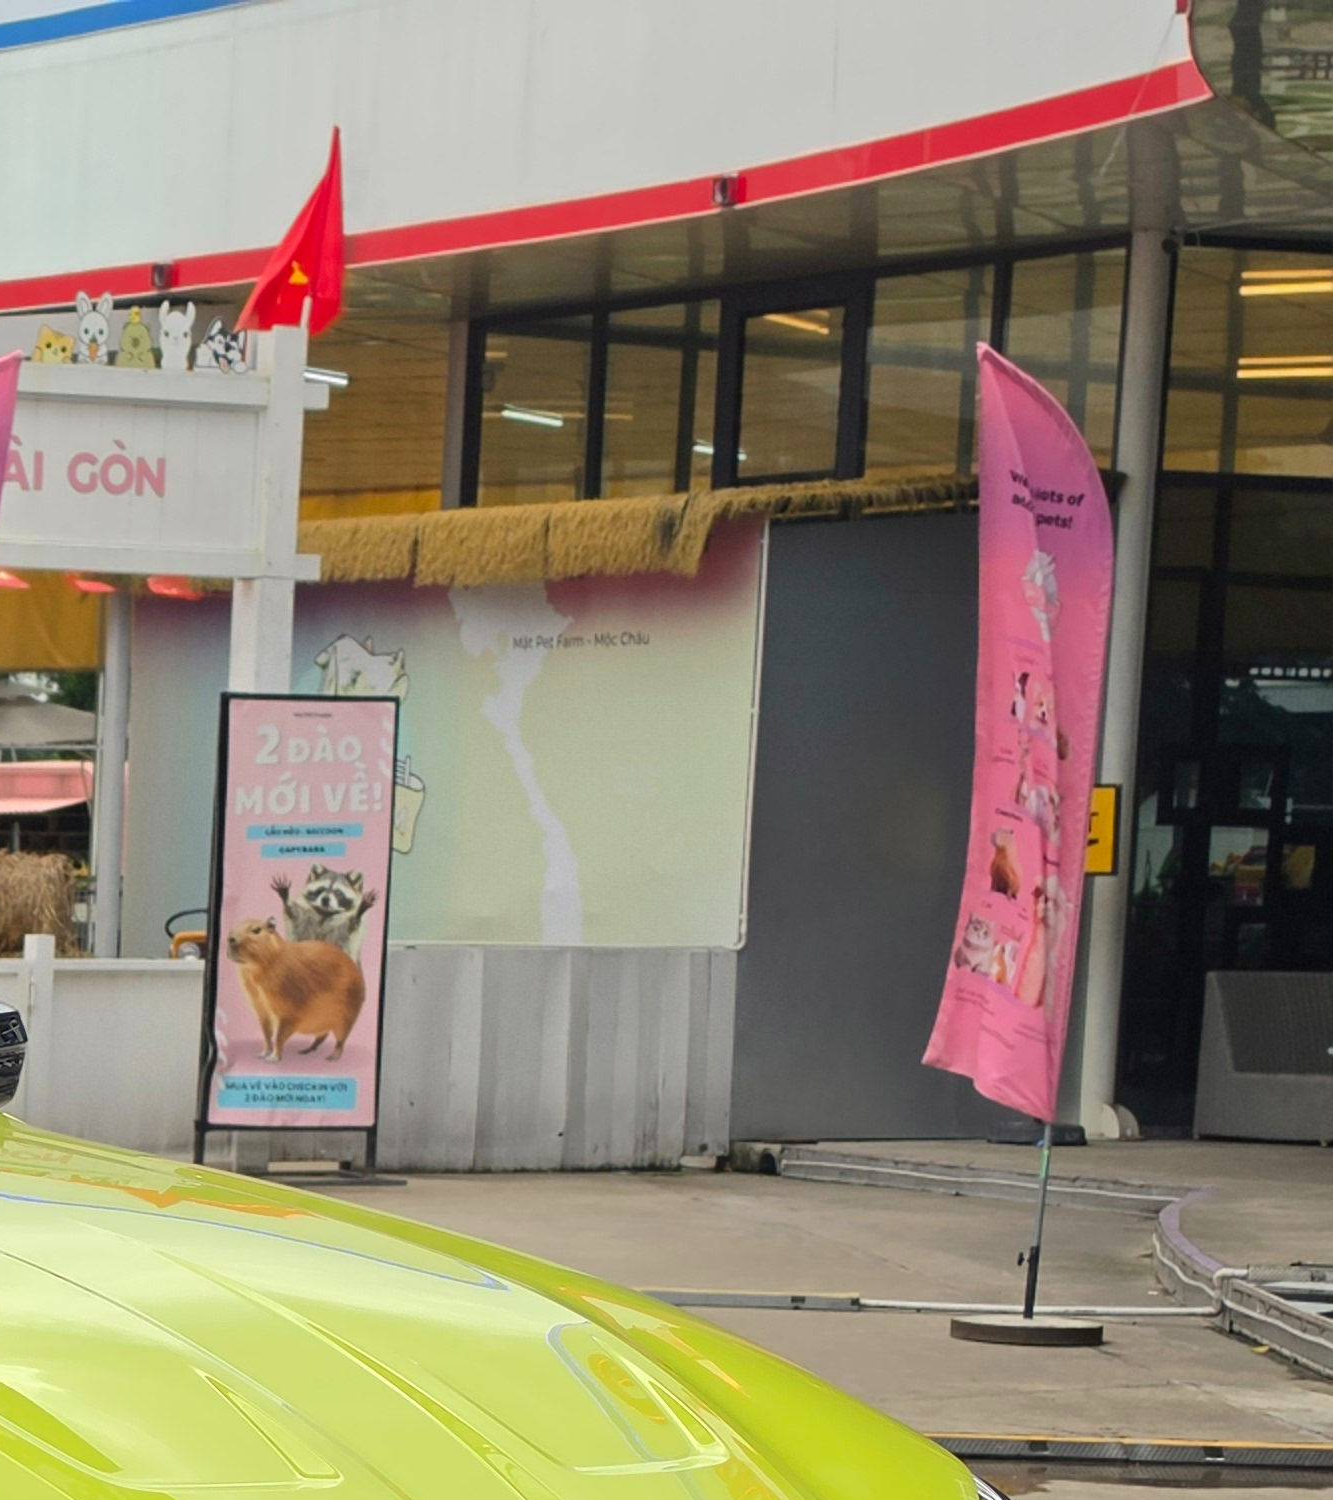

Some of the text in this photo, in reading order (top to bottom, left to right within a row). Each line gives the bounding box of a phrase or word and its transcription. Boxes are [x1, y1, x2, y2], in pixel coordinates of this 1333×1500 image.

[4, 433, 167, 499] ÀI GÒN
[556, 632, 584, 649] Farm
[619, 630, 651, 646] Châu
[254, 723, 363, 766] 2 ĐÀO
[235, 761, 383, 816] MỚI VỀ!
